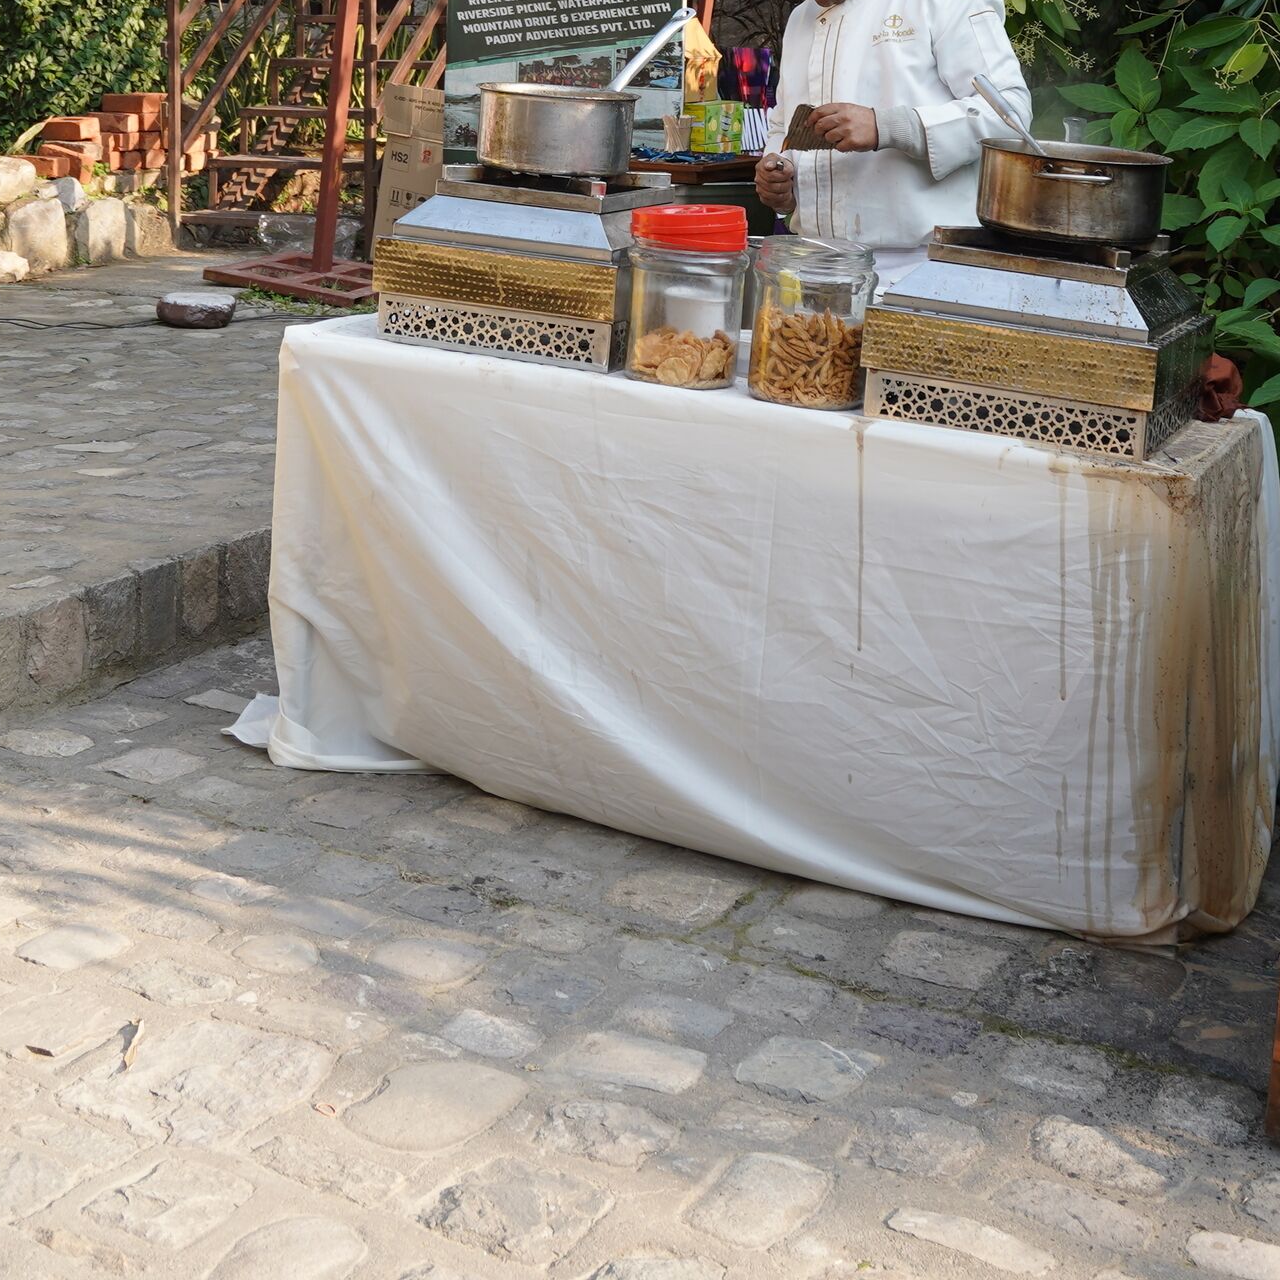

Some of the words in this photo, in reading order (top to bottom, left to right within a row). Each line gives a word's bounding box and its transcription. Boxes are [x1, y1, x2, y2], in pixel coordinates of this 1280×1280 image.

[456, 6, 515, 21] RIVERSIDE
[516, 1, 557, 14] PICNIC,
[463, 19, 523, 34] MOUNTAIN
[524, 15, 559, 27] DRIVE
[560, 14, 569, 24] &
[571, 6, 640, 23] EXPERIENCE
[641, 2, 672, 15] WITH
[485, 32, 523, 46] PADDY
[526, 24, 599, 41] ADVENTURES
[600, 21, 627, 33] PVT.
[629, 19, 655, 31] LTD.
[391, 150, 409, 165] HS2
